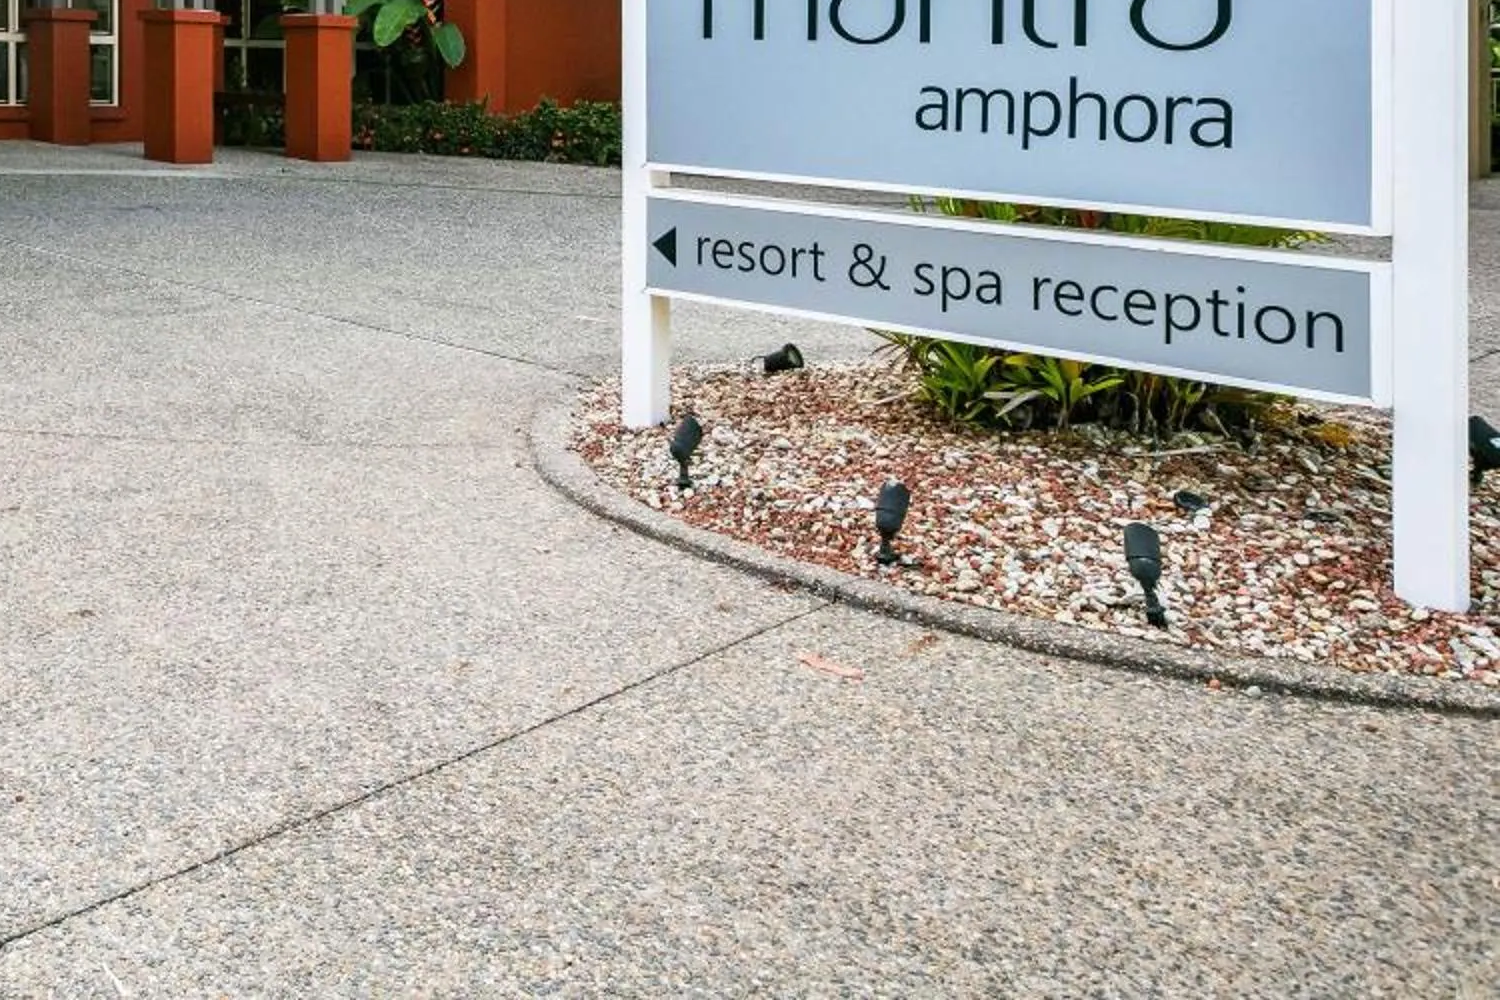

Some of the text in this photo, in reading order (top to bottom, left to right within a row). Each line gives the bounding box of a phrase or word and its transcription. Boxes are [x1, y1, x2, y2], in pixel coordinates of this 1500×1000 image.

[914, 76, 1234, 150] amphora
[695, 234, 1345, 353] resort & spa reception
